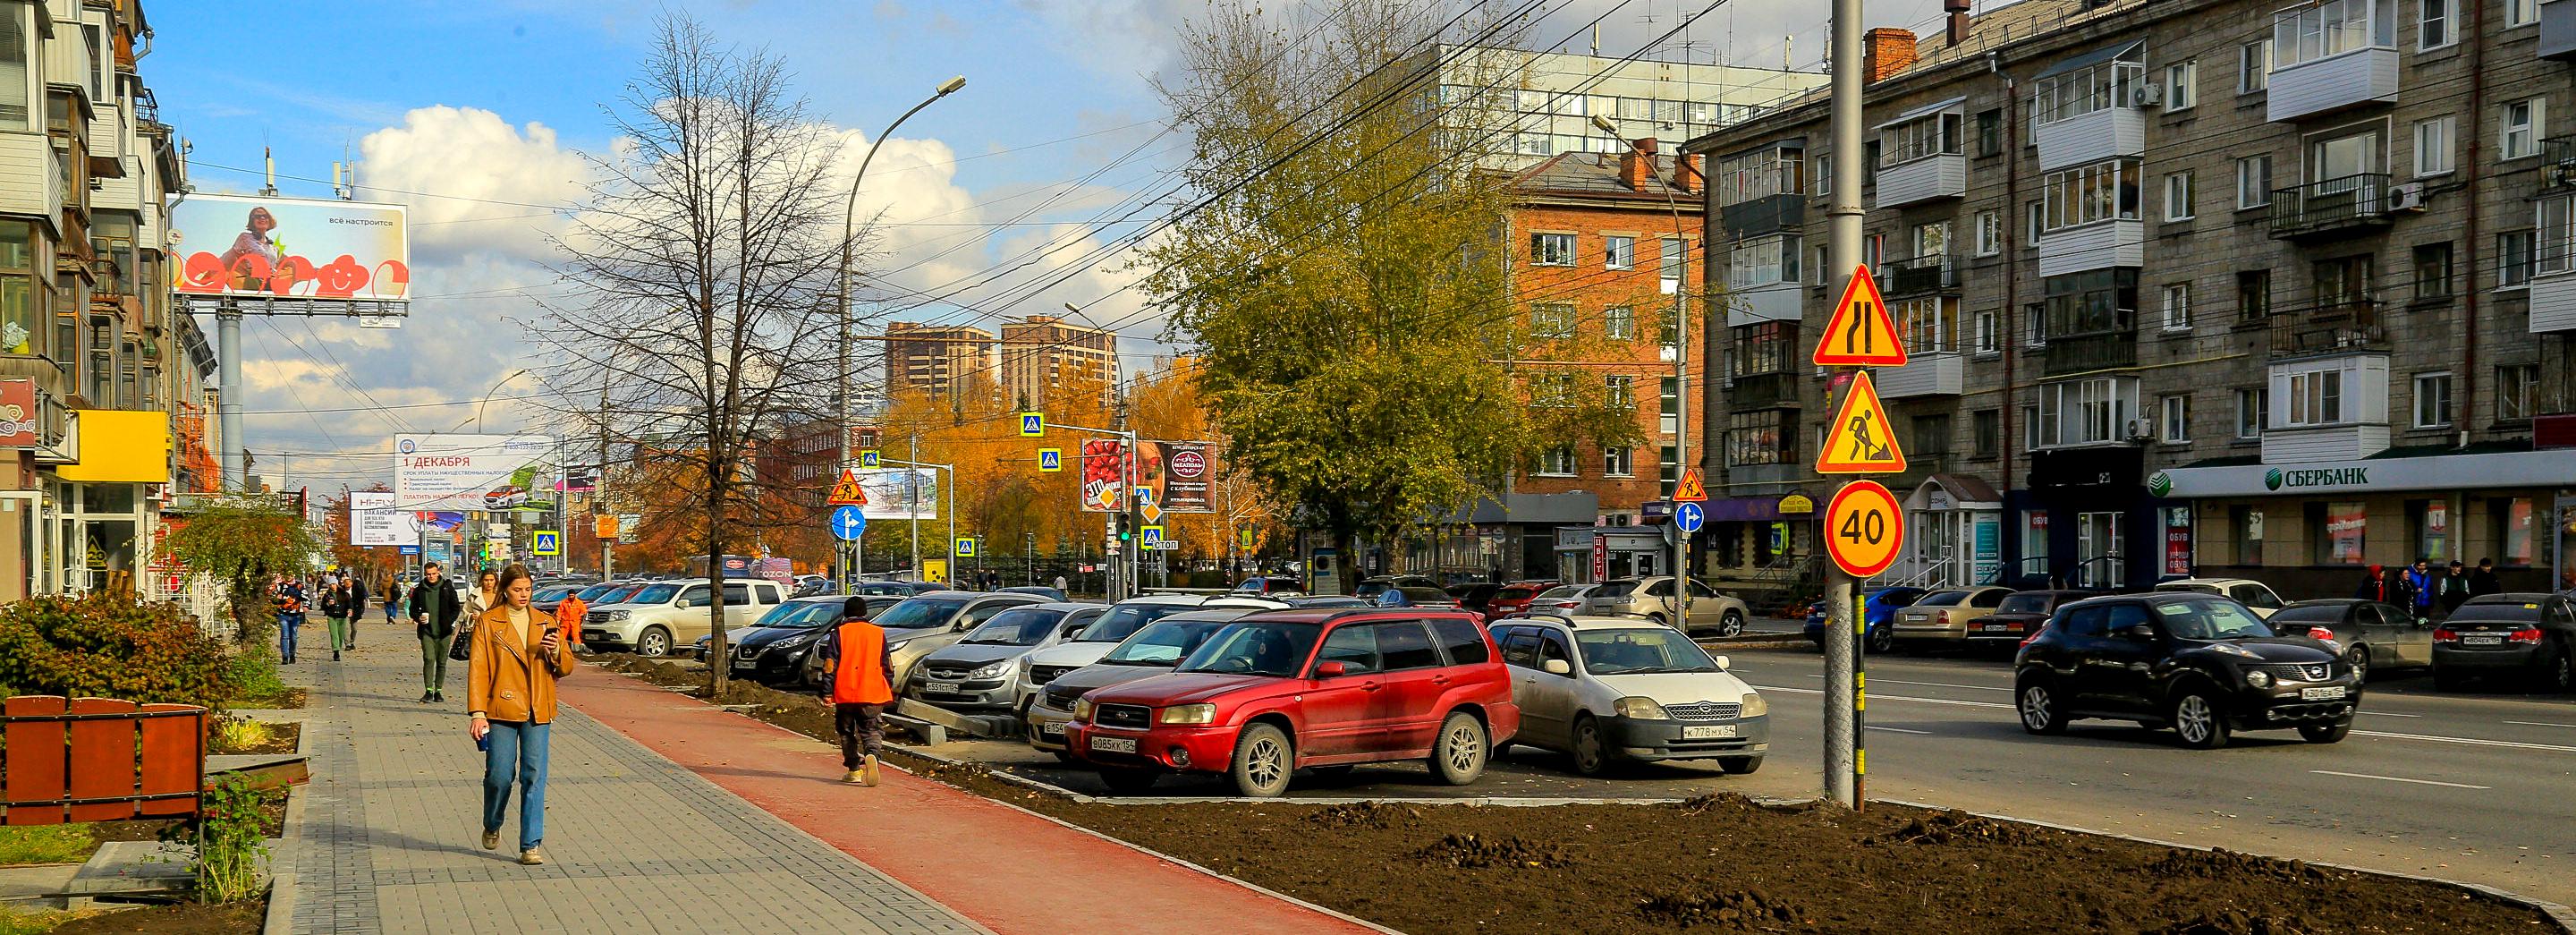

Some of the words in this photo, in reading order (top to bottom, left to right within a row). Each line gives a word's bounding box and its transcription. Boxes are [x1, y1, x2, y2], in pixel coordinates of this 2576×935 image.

[345, 218, 393, 226] настроится
[403, 457, 409, 466] 1
[414, 457, 470, 469] ДЕКАБРЯ
[2285, 467, 2368, 487] СБЕРБАНК
[1086, 479, 1105, 497] ЭТО
[1841, 508, 1884, 545] 40
[1155, 541, 1176, 549] СТОП
[1707, 534, 1716, 548] 14
[1595, 539, 1603, 582] ЦВЕТЫ
[2169, 560, 2189, 569] ОБУВ
